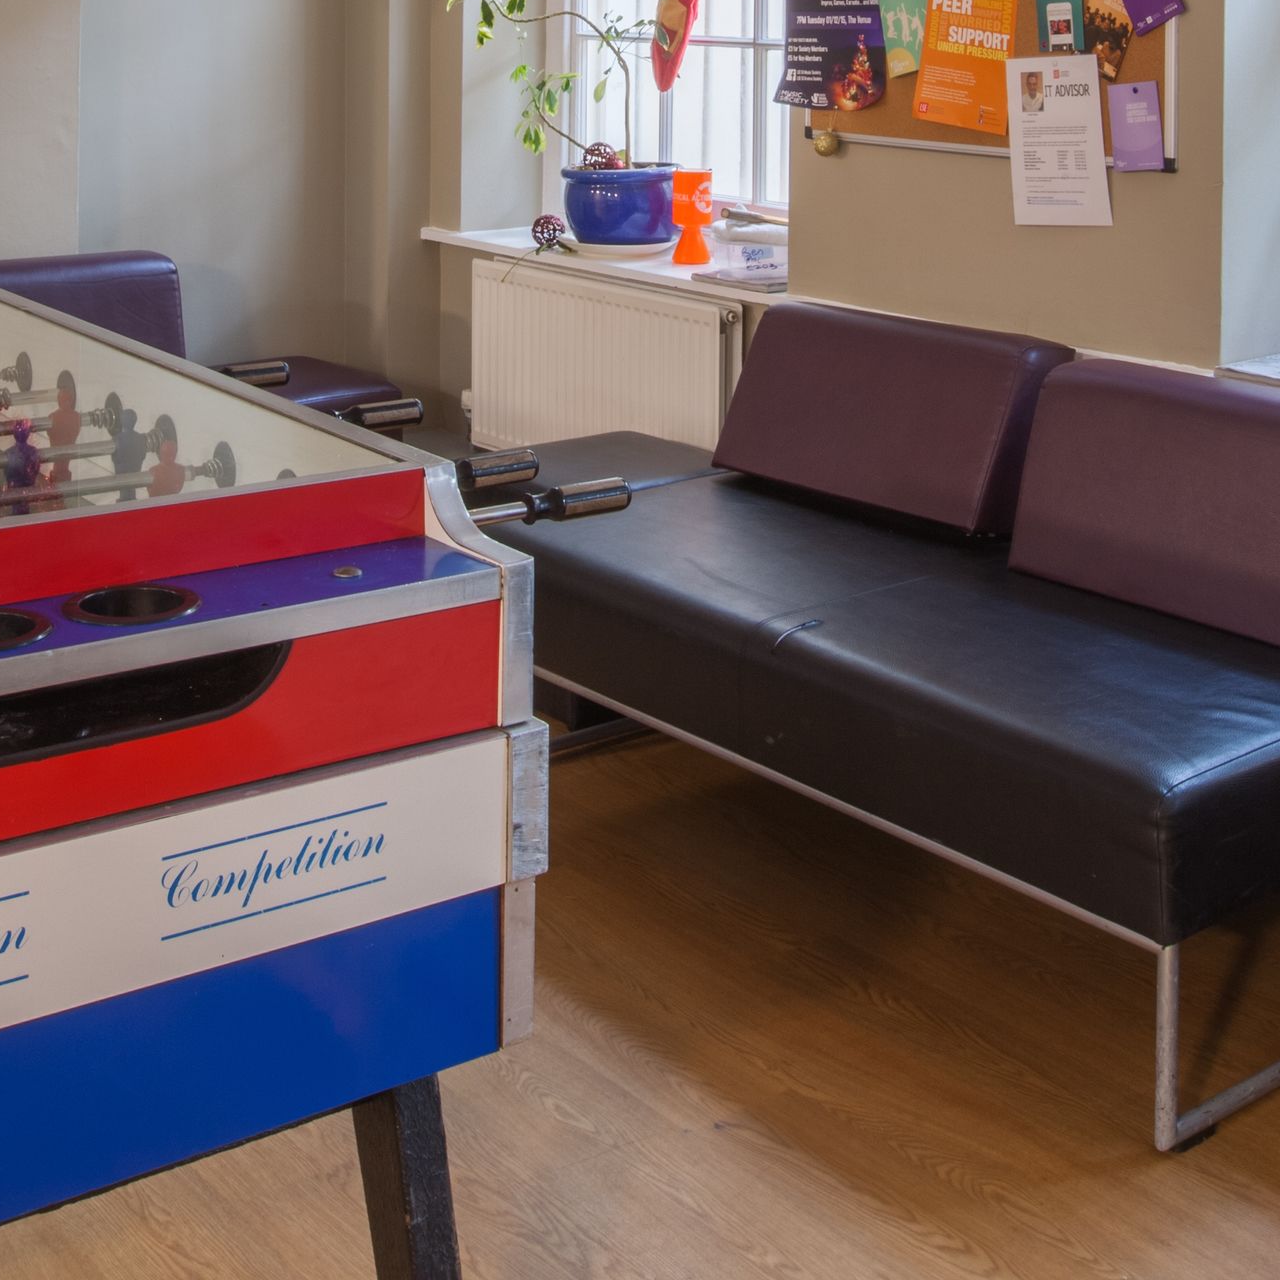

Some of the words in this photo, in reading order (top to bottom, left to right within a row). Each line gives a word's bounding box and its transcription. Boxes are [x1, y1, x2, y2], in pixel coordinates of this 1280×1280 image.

[949, 12, 1001, 31] WORRIED
[948, 25, 1010, 51] SUPPORT
[937, 41, 965, 55] UNDER
[966, 45, 1008, 61] PRESSURE
[1044, 84, 1054, 98] IT
[1054, 83, 1091, 97] ADVISOR
[161, 829, 387, 908] Competition
